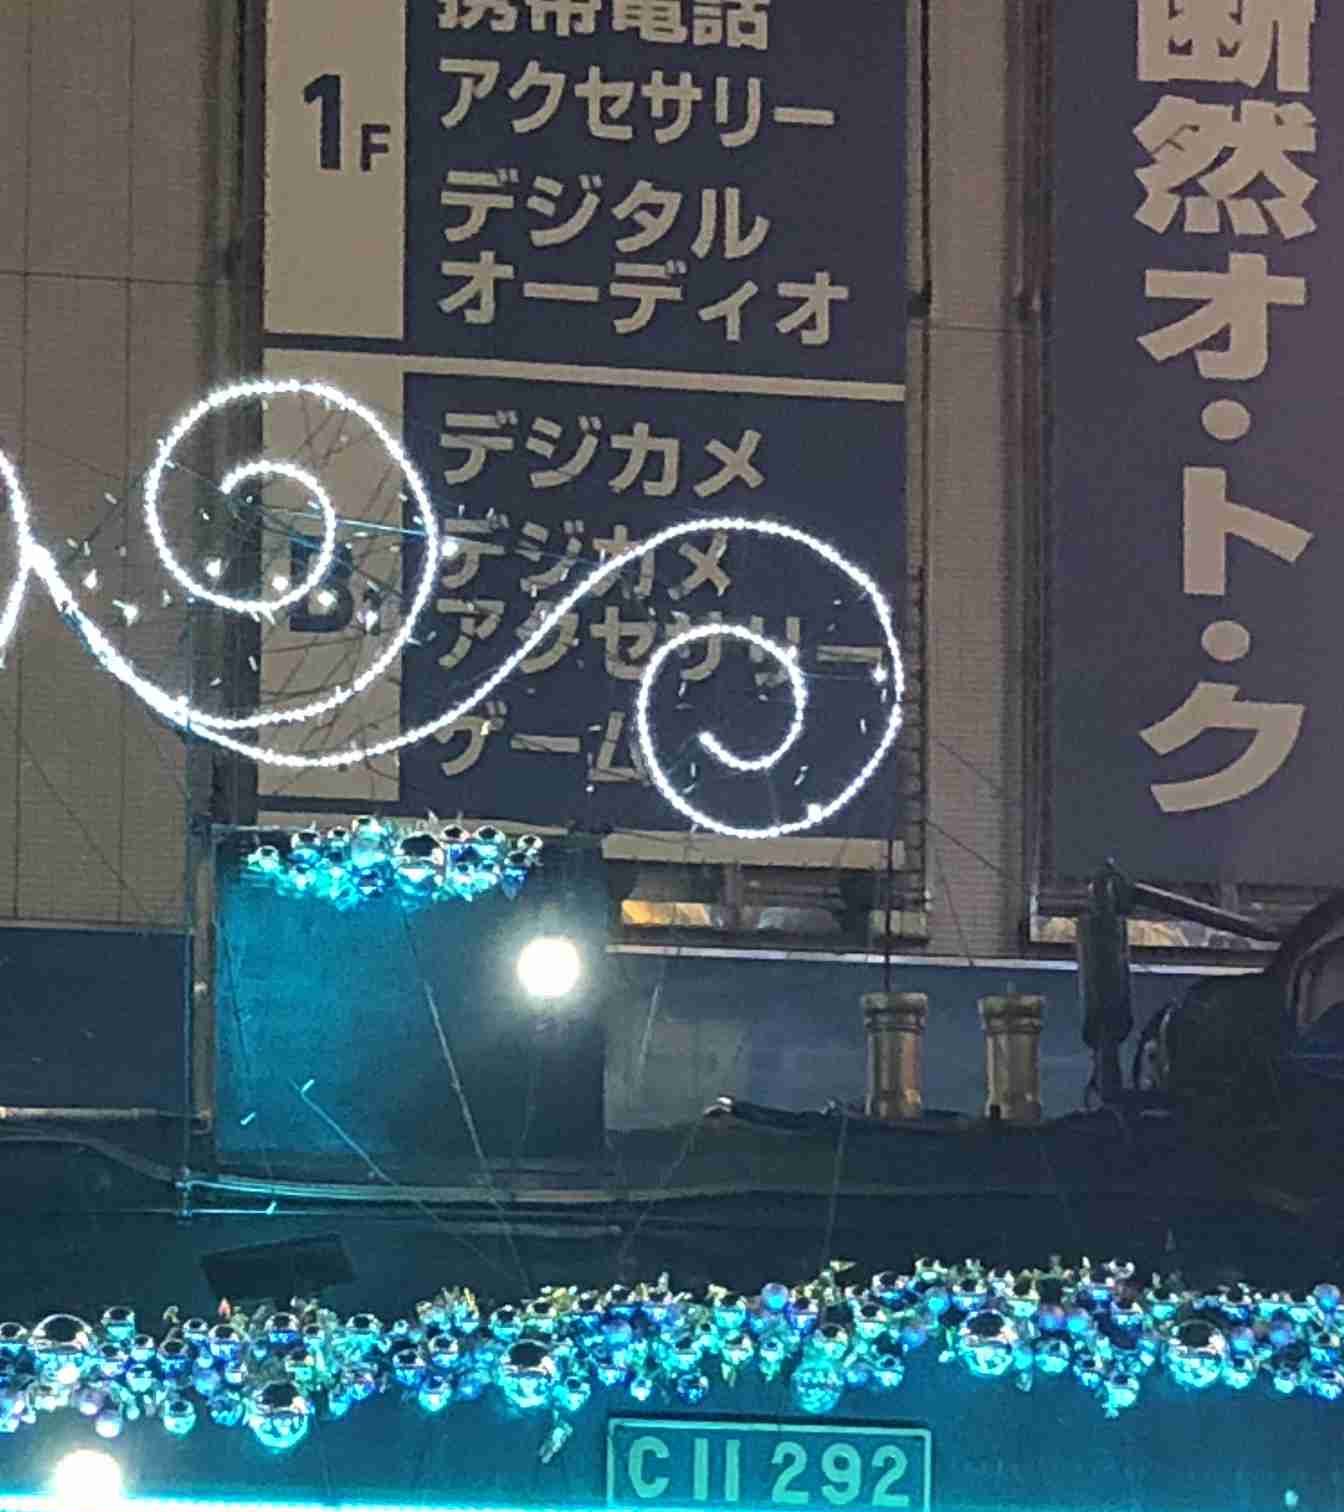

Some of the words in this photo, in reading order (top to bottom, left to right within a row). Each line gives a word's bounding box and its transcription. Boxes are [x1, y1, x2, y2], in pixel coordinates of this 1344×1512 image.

[303, 73, 391, 172] 1F
[439, 57, 836, 149] アクセサリー
[439, 166, 770, 260] デジタル
[439, 250, 851, 346] オーディオ
[439, 410, 765, 499] デジカメ
[439, 513, 732, 601] デジカメ
[438, 598, 884, 690] アクセサリー
[434, 701, 650, 784] ゲーム
[771, 1441, 910, 1507] 292
